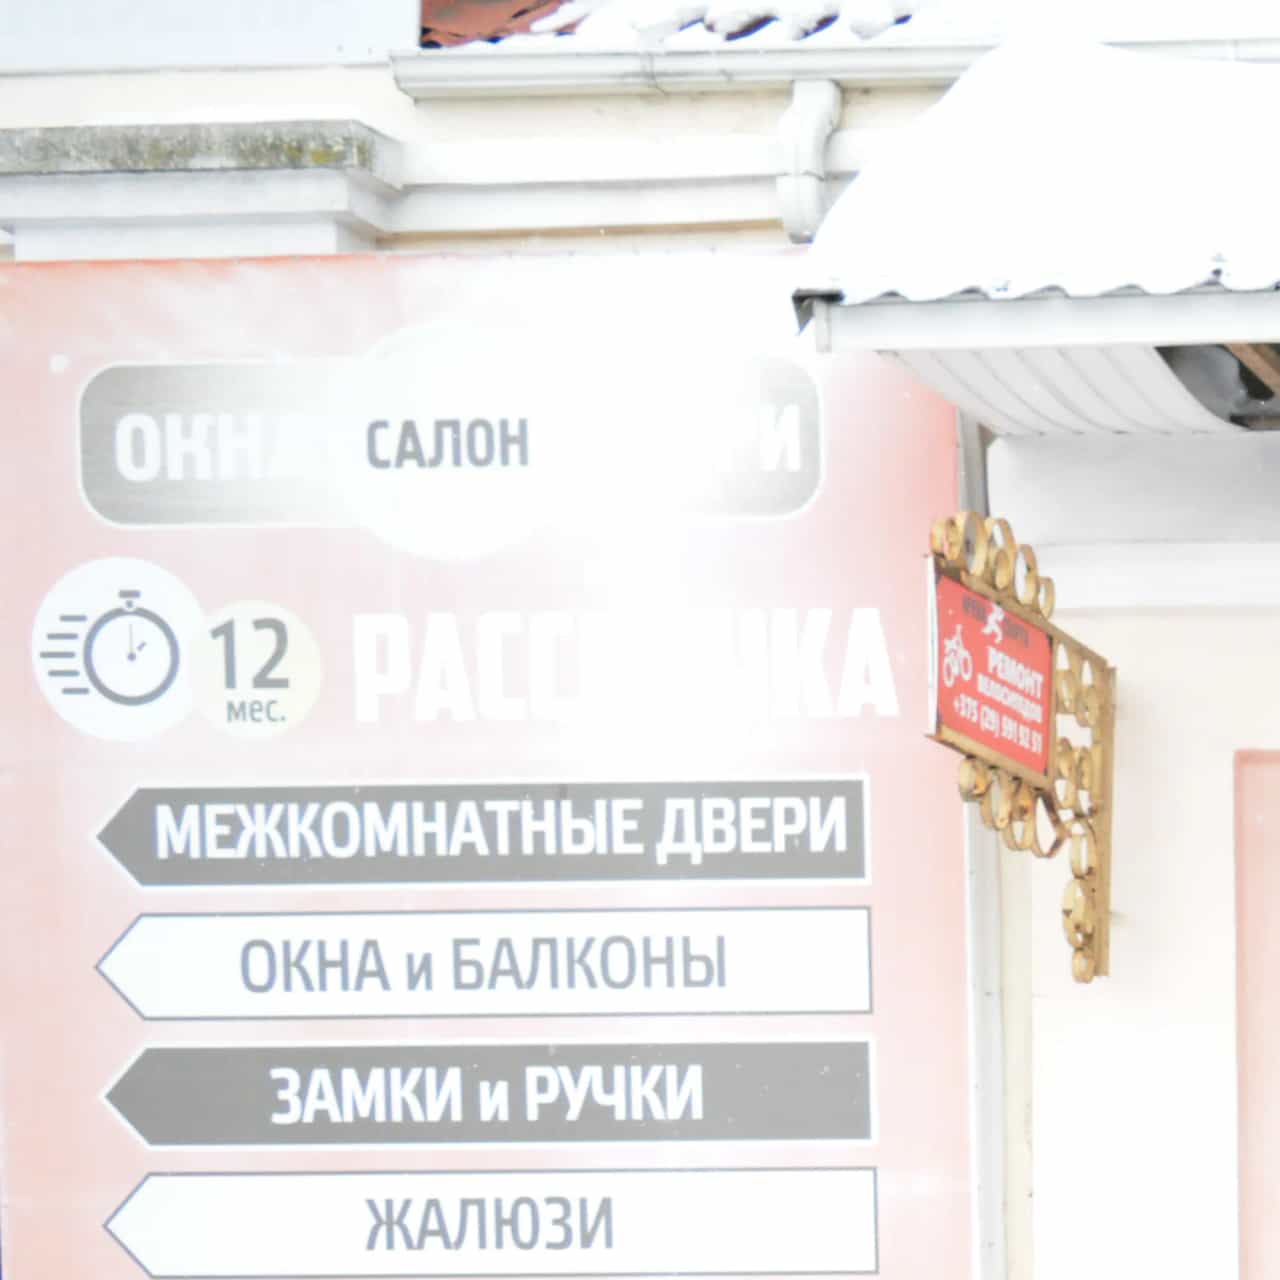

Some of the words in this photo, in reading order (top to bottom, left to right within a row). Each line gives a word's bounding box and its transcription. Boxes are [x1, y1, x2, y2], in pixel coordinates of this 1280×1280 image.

[114, 412, 308, 482] ОКН
[366, 417, 530, 470] САЛОН
[210, 617, 290, 690] 12
[352, 607, 900, 724] РАССЧКА
[987, 645, 1043, 699] РЕМОНТ
[226, 699, 287, 724] мес.
[154, 797, 645, 861] МЕЖКОМНАТНЫЕ
[655, 796, 848, 866] ДВЕРИ
[240, 938, 391, 994] ОКНА
[406, 951, 433, 992] и
[451, 934, 728, 992] БАЛКОНЫ
[269, 1066, 463, 1125] ЗАМКИ
[480, 1078, 509, 1122] и
[525, 1064, 704, 1122] РУЧКИ
[365, 1197, 615, 1252] ЖАЛЮЗИ
